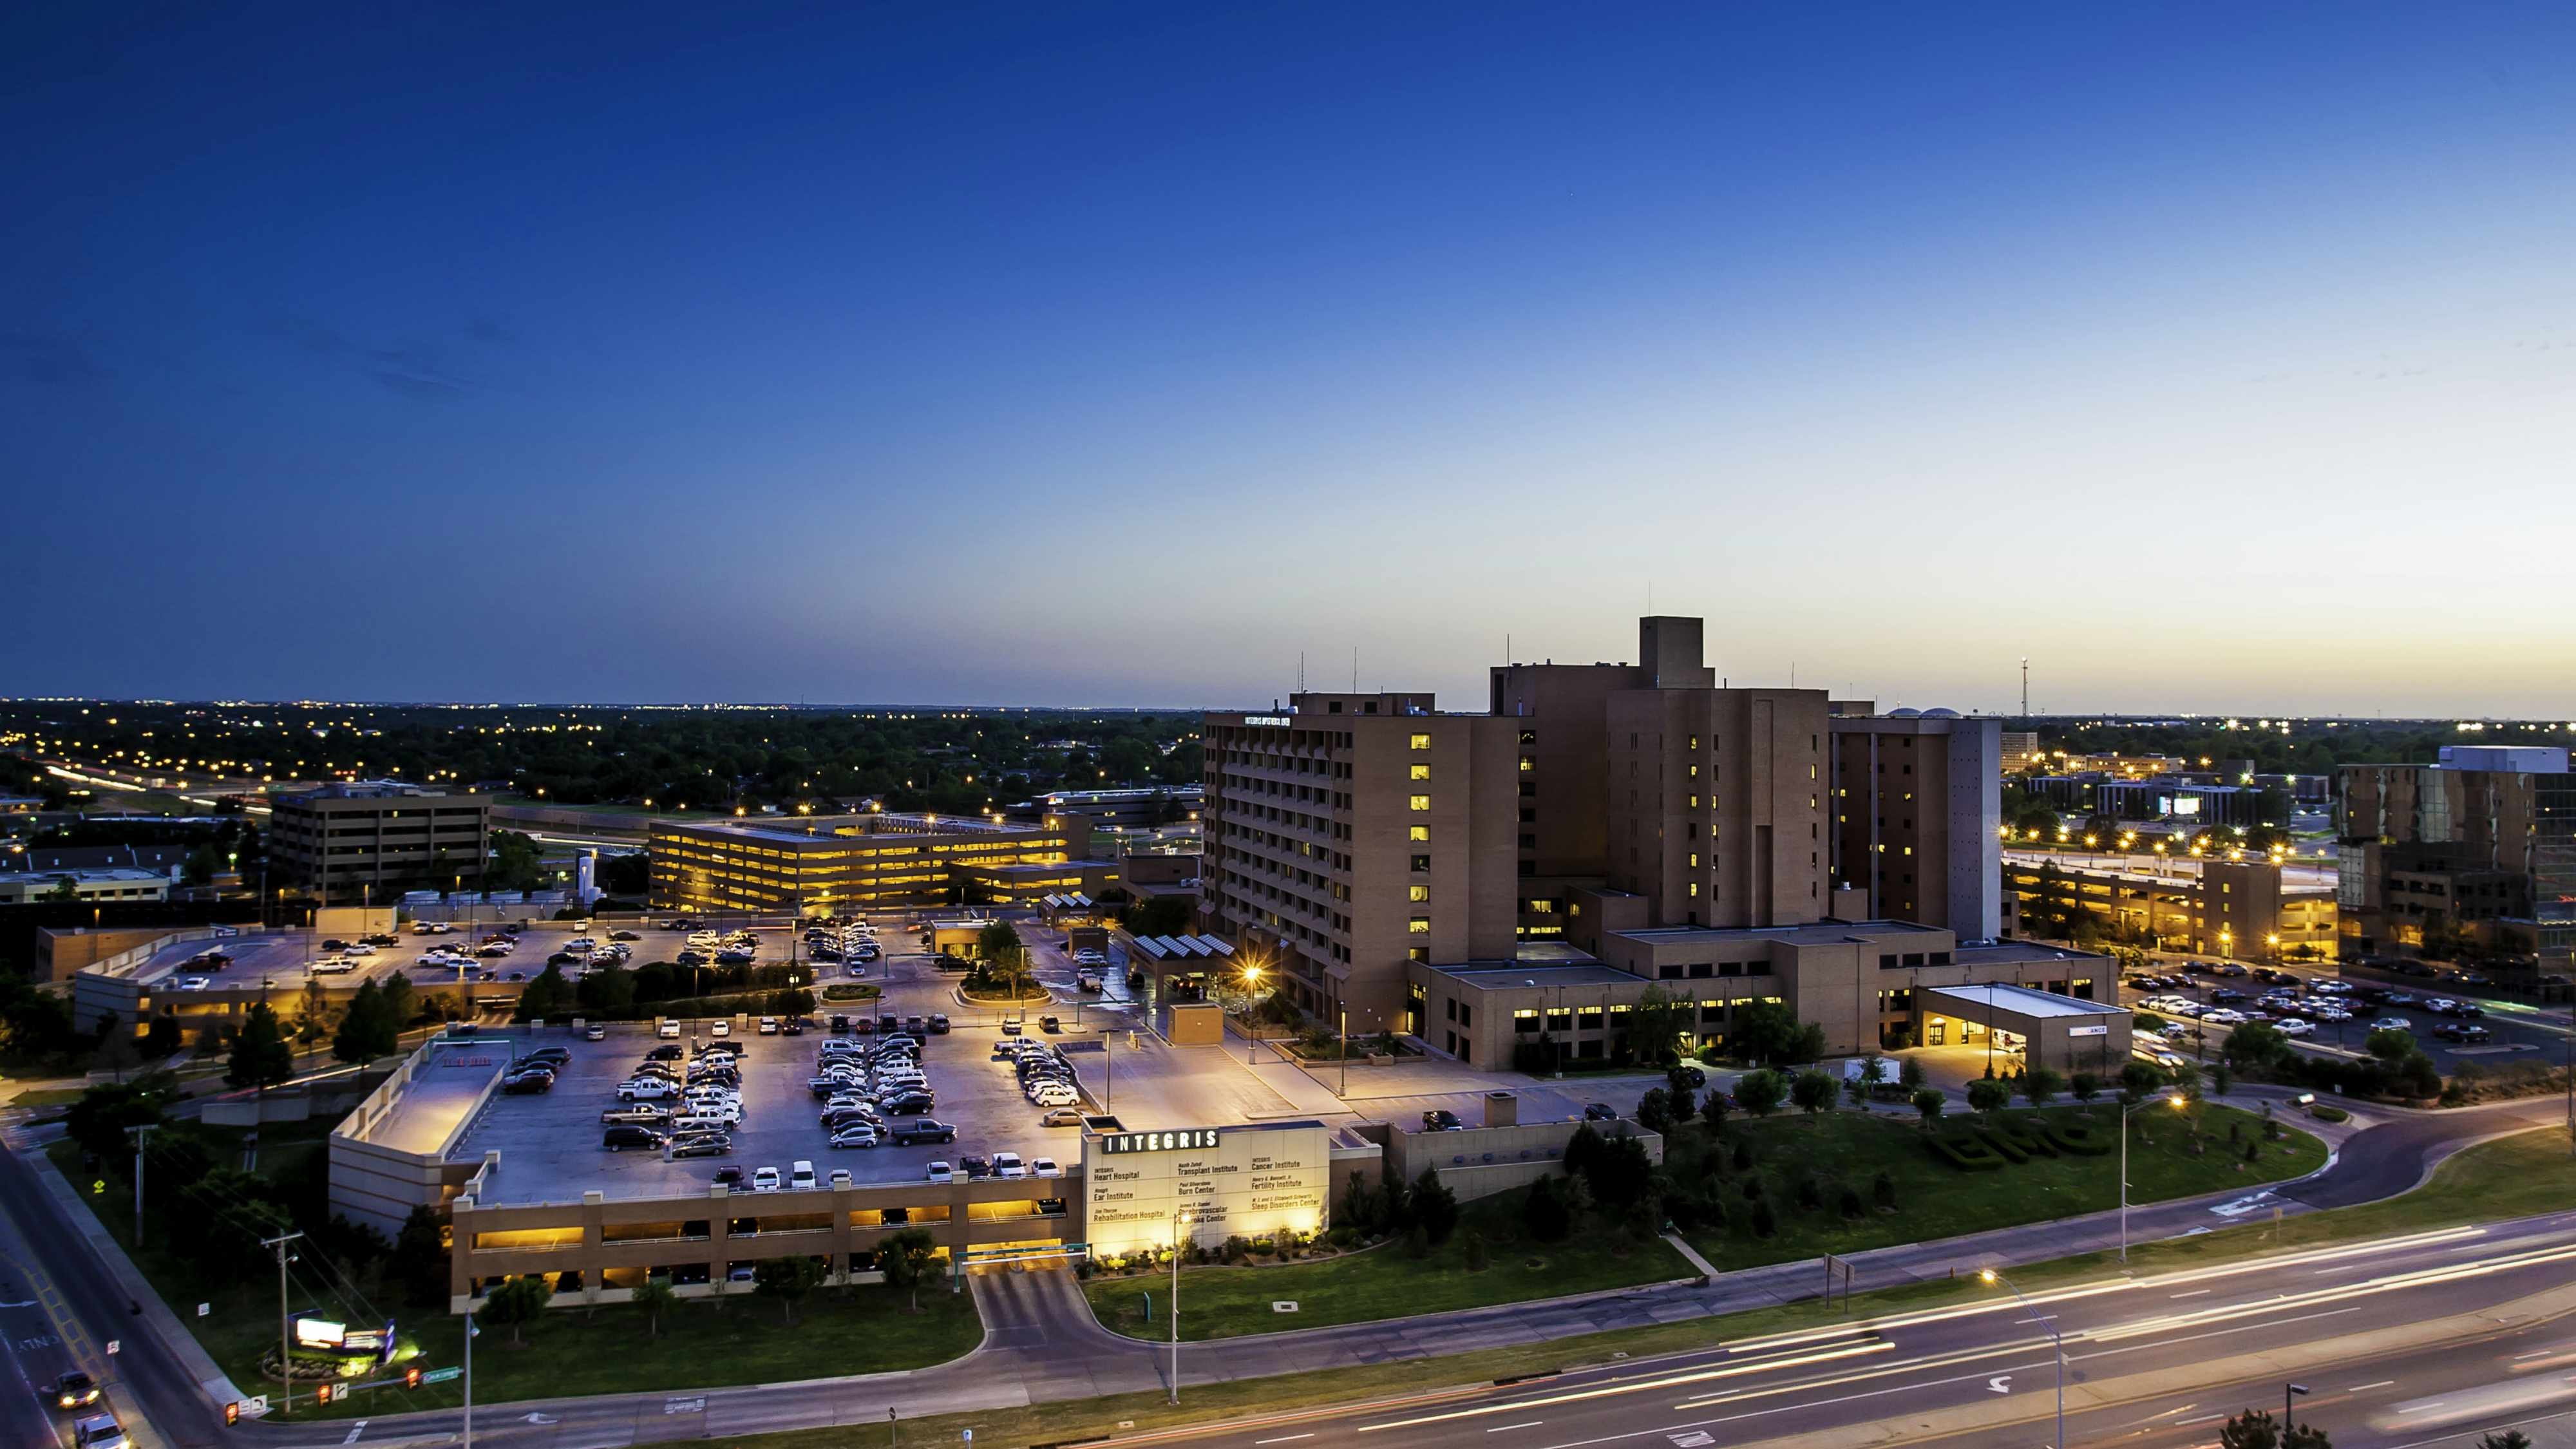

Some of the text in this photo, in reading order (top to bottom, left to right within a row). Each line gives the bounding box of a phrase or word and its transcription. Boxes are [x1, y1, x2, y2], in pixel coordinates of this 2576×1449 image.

[1108, 1130, 1216, 1151] INTEGRIS
[1274, 1160, 1300, 1169] Institute
[1178, 1165, 1238, 1176] Transplant Institute
[1113, 1171, 1139, 1181] Hospital
[1106, 1192, 1133, 1200] Institute
[1179, 1206, 1227, 1215] Cebrovascular
[1252, 1202, 1268, 1211] Sleep
[1269, 1201, 1298, 1209] Disorders
[1094, 1210, 1165, 1222] Rehabilitation Hospital
[1206, 1215, 1226, 1223] Center
